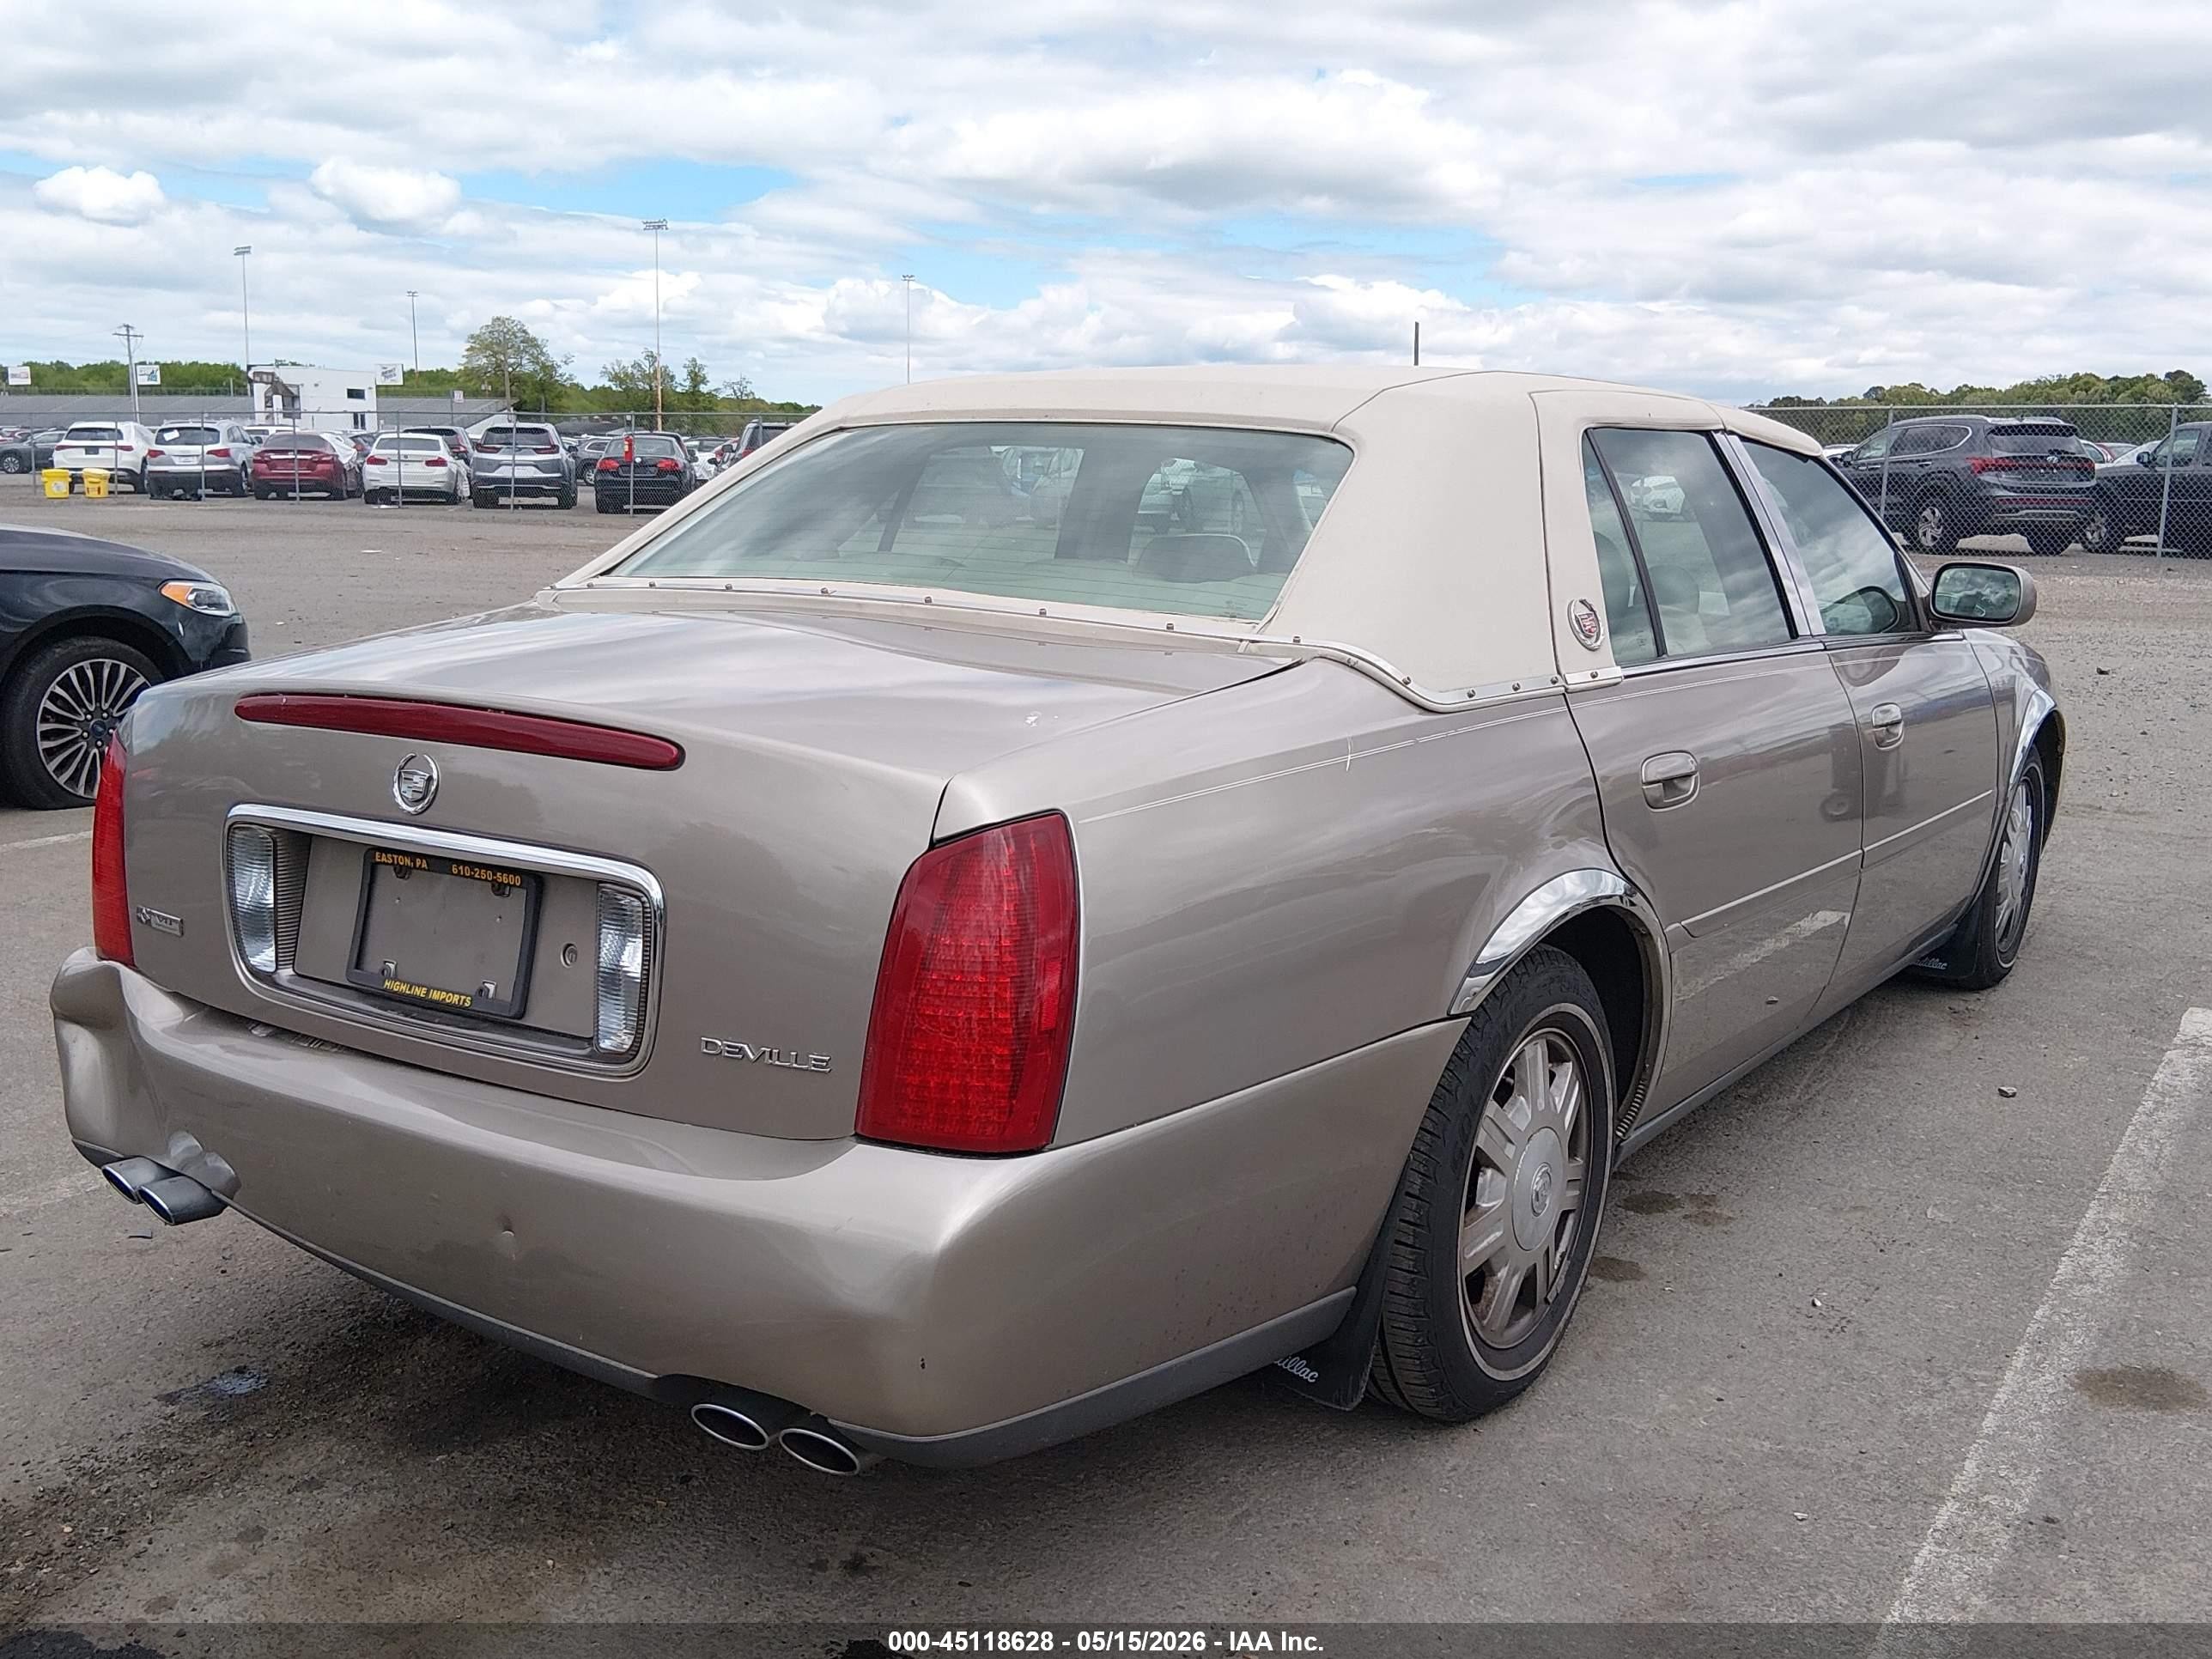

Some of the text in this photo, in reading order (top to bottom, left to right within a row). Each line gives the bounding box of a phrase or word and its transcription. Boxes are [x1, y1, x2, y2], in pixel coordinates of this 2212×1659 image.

[375, 852, 521, 886] EASTON, PA 610-250-5600
[384, 979, 471, 1007] HIGHLINE IMPORTS
[701, 1036, 832, 1073] DEVILLE
[1273, 1356, 1319, 1382] illac
